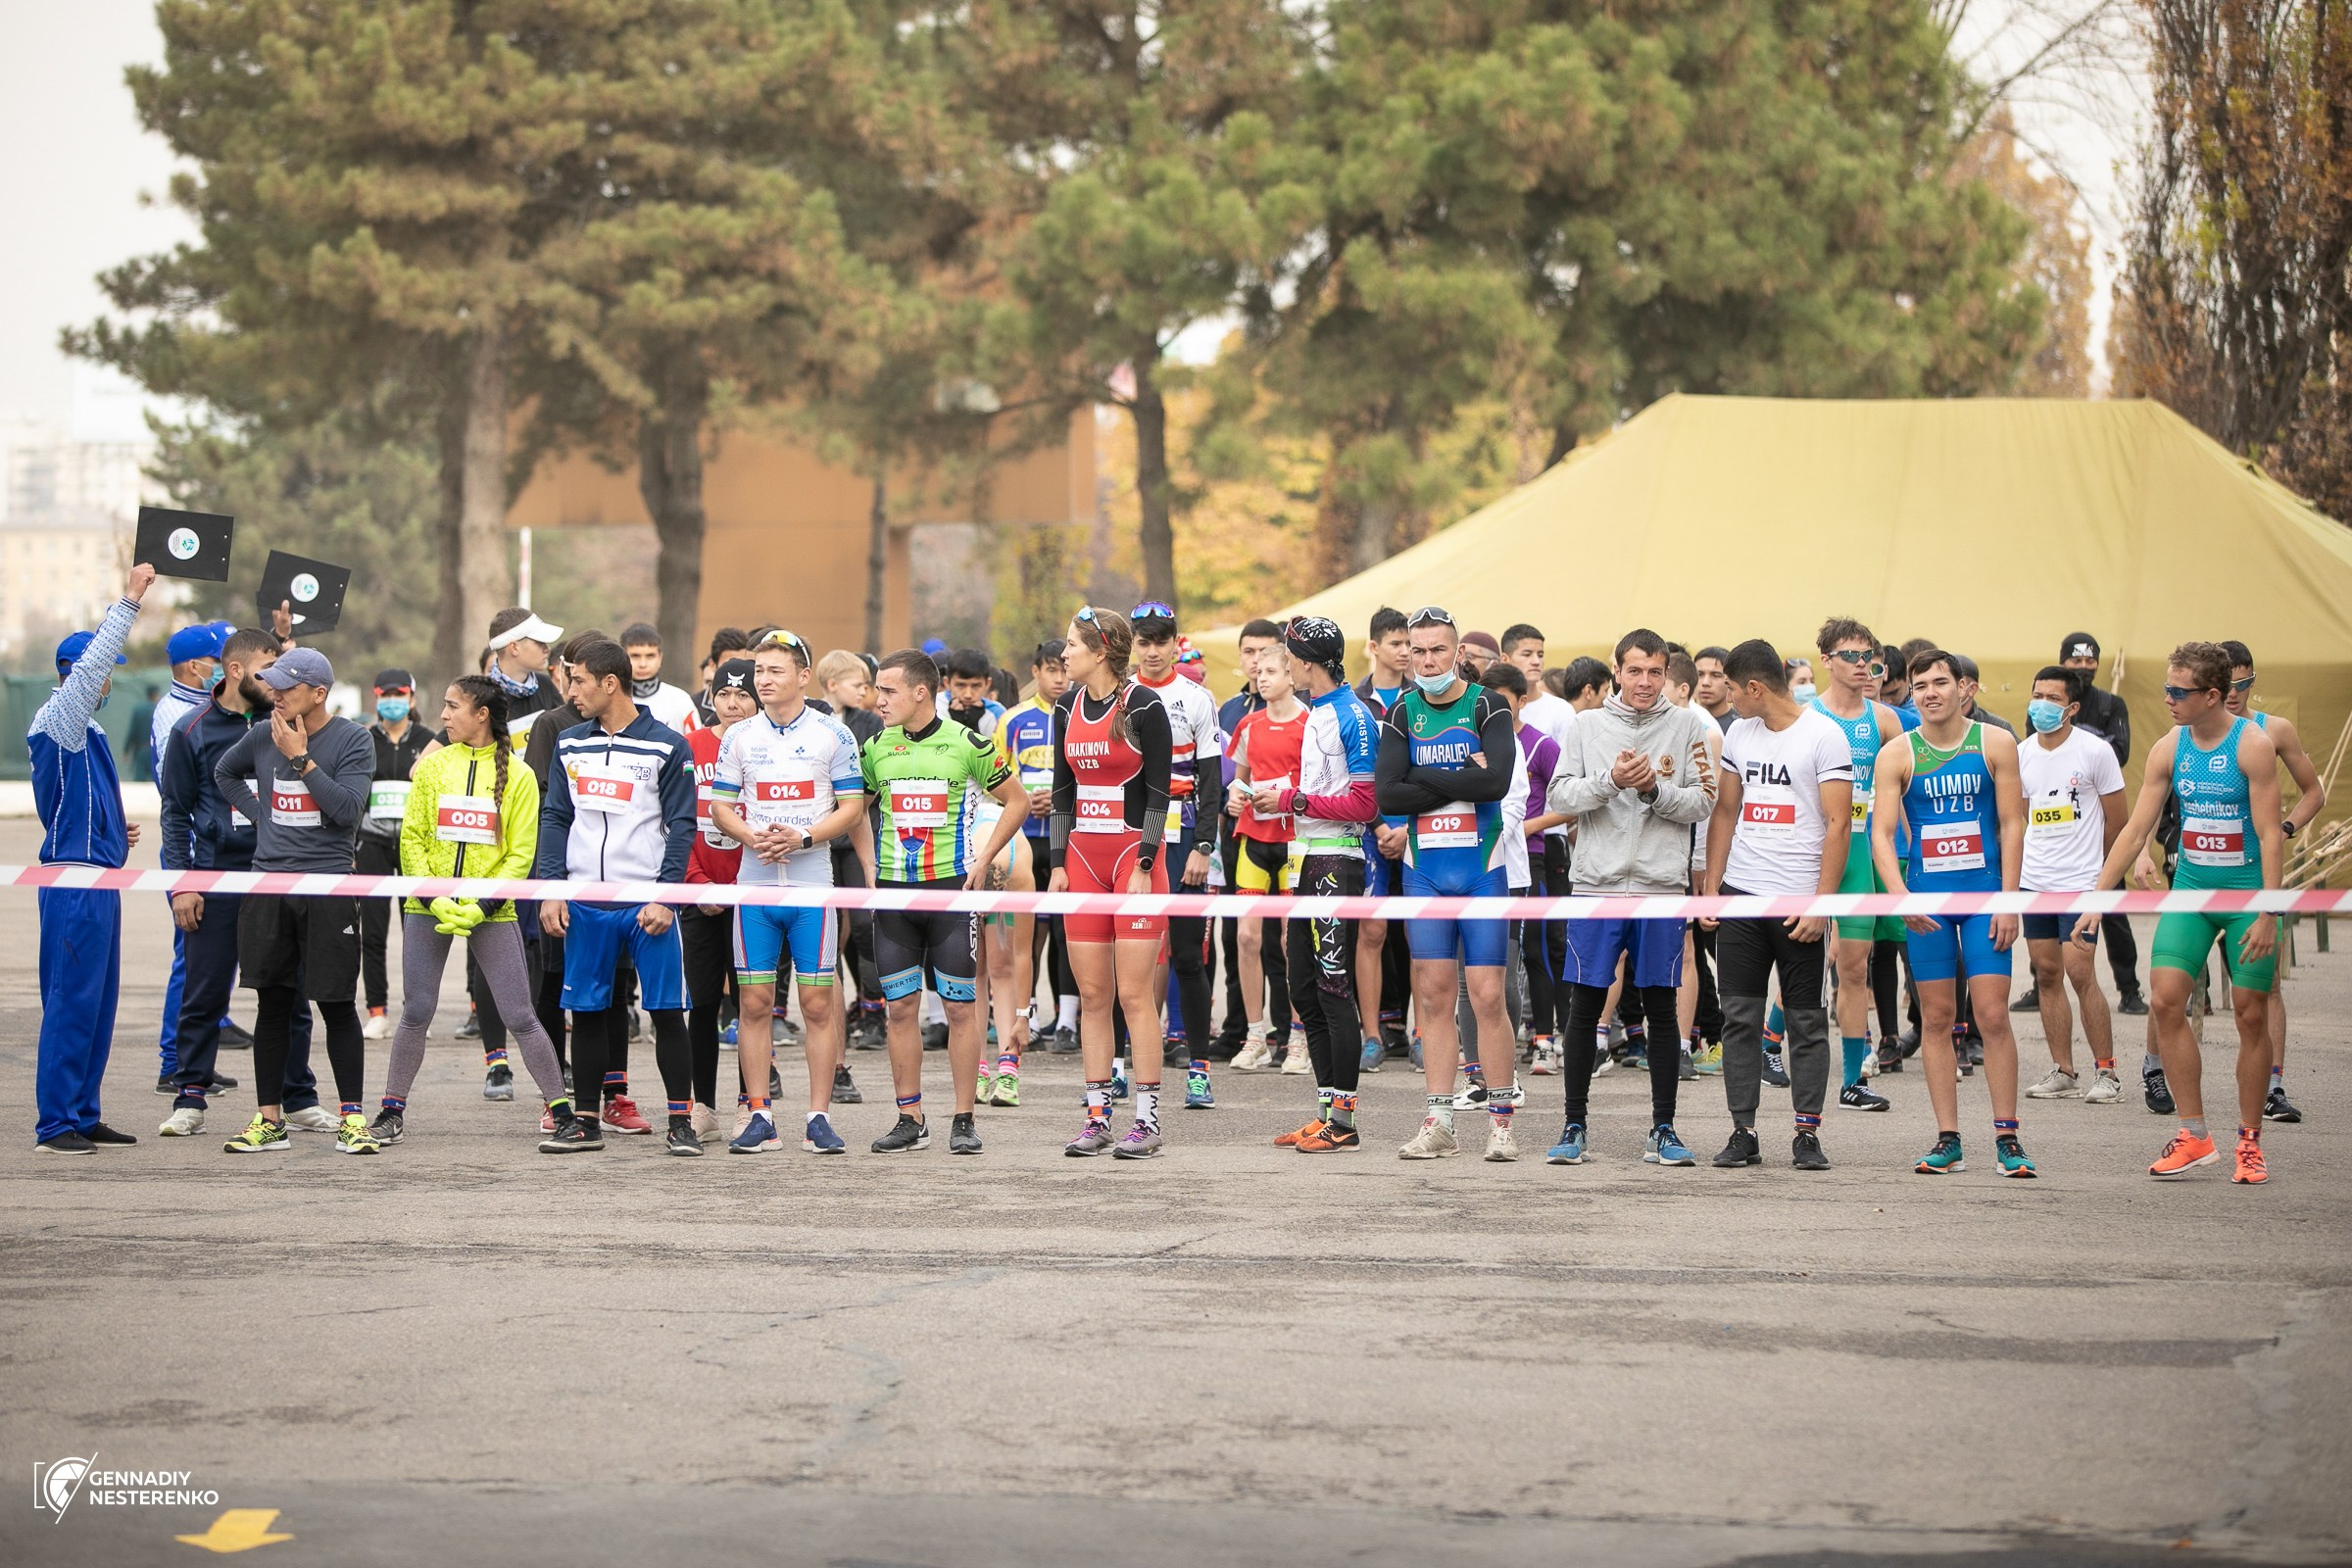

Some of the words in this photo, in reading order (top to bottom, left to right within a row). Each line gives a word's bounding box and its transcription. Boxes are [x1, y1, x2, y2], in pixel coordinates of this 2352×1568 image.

[1349, 703, 1368, 757] UZBEKISTAN
[1067, 741, 1110, 758] KHAKIMOVA
[1416, 742, 1470, 765] UMARALIEV
[624, 764, 652, 780] ZB
[1077, 760, 1100, 769] UZB
[1745, 760, 1791, 786] FILA
[587, 780, 617, 796] 018
[878, 775, 959, 788] candle
[1924, 773, 1982, 799] ALIMOV
[769, 785, 801, 799] 014
[277, 796, 302, 810] 011
[902, 797, 932, 810] 015
[1081, 802, 1111, 816] 004
[451, 811, 488, 827] 005
[774, 814, 813, 826] nordisk
[1752, 806, 1779, 821] 017
[2035, 810, 2061, 822] 035
[1431, 816, 1461, 831] 019
[1936, 839, 1970, 855] 012
[2196, 835, 2228, 851] 013
